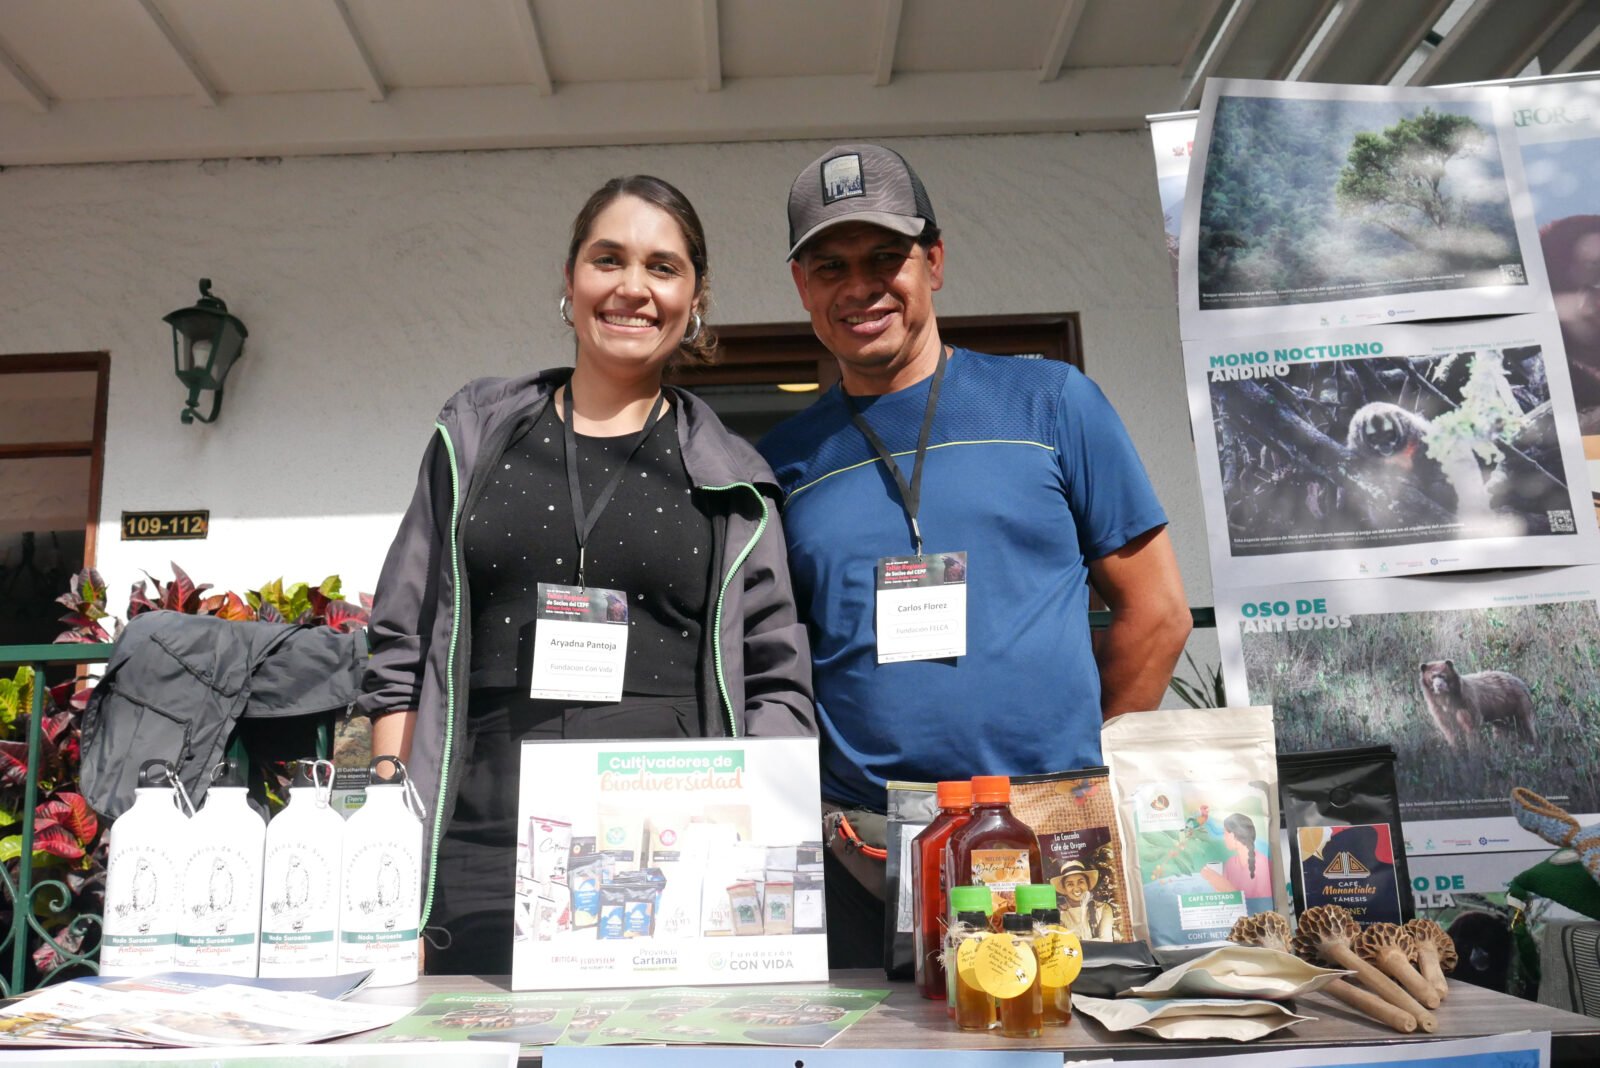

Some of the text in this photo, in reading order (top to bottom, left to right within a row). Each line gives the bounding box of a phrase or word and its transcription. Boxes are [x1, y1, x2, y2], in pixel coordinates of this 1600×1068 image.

[1210, 342, 1383, 368] MONO NOCTURNO
[1211, 364, 1290, 382] ANDINO
[128, 516, 202, 534] 109-112
[1242, 598, 1327, 617] OSO DE
[1244, 615, 1352, 634] ANTEOJOS
[550, 638, 616, 651] Aryadna Pantoja
[609, 755, 733, 769] Cultivadores de
[600, 767, 744, 791] Biodiversidad
[1061, 832, 1080, 840] Cascada
[1070, 842, 1087, 850] Origen
[1435, 876, 1465, 890] DE
[1322, 885, 1376, 895] Manantiales
[1345, 907, 1367, 916] ONEY
[1188, 932, 1209, 940] CONT.
[632, 956, 678, 966] Cartama
[729, 960, 794, 970] CON VIDA
